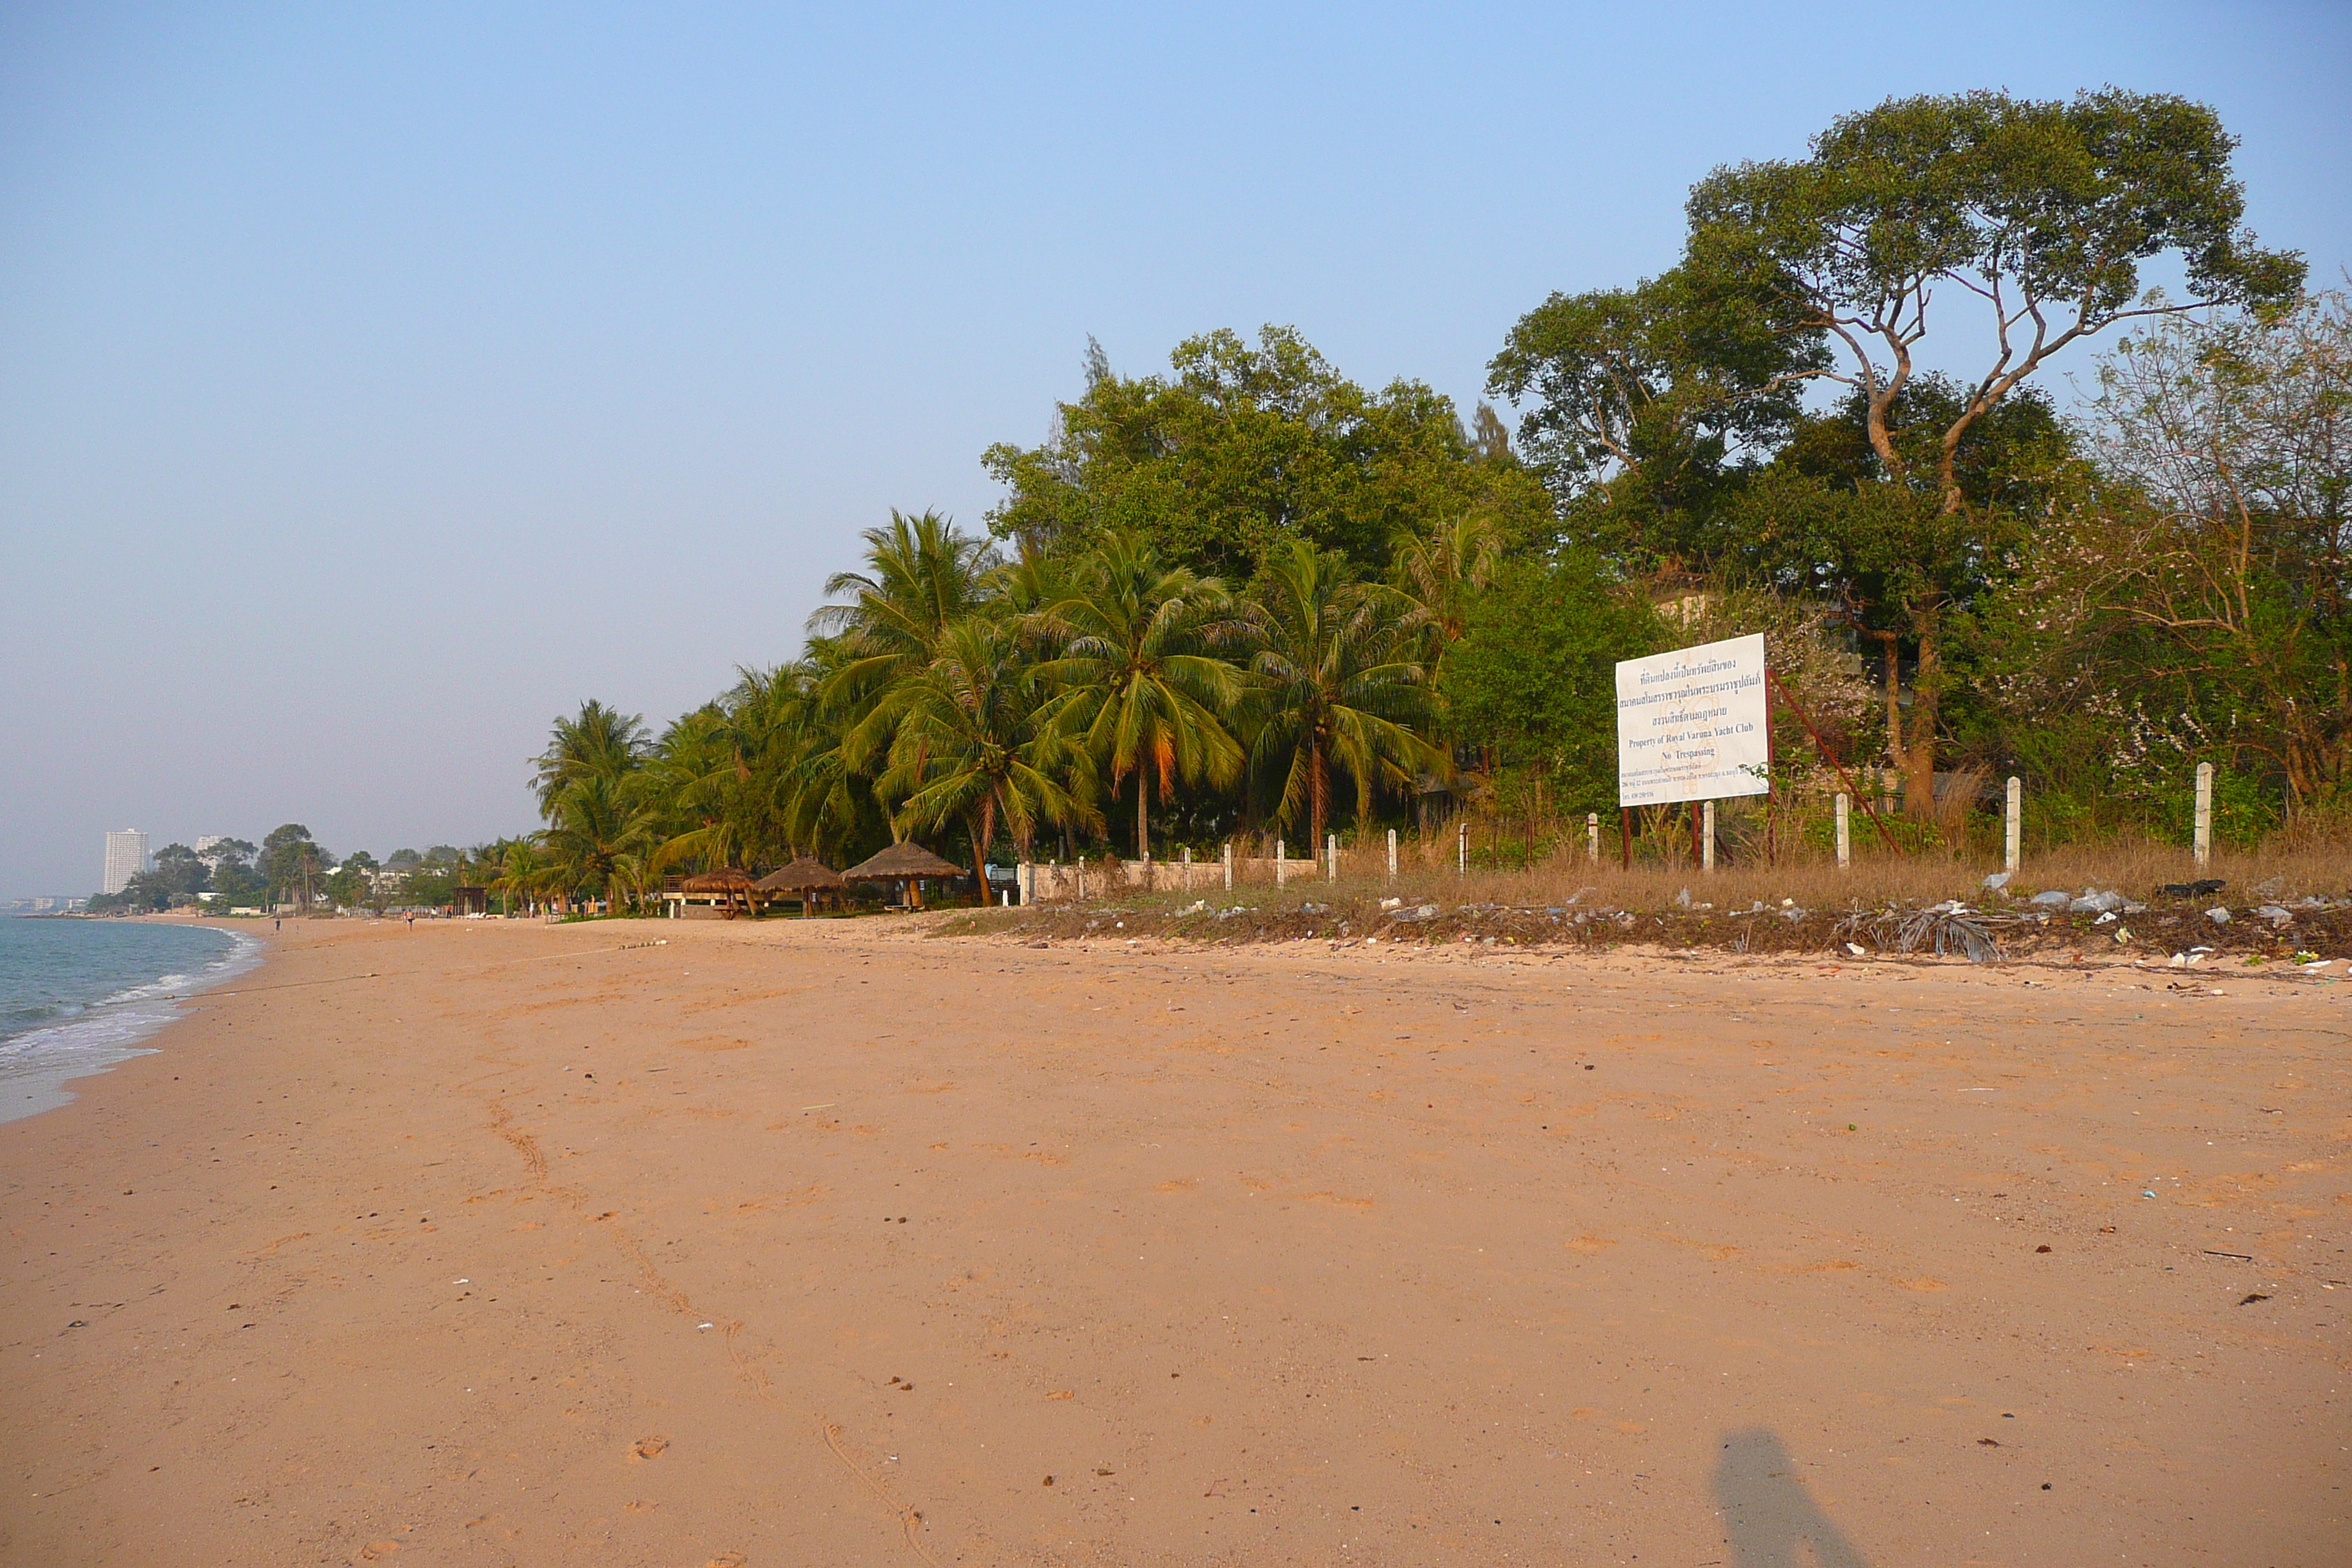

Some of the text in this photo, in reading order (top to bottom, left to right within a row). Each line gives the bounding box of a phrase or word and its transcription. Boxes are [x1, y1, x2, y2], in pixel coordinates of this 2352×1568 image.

[1629, 722, 1754, 749] Property of Royal Varuna Yacht Club
[1662, 747, 1715, 760] No Trespassing
